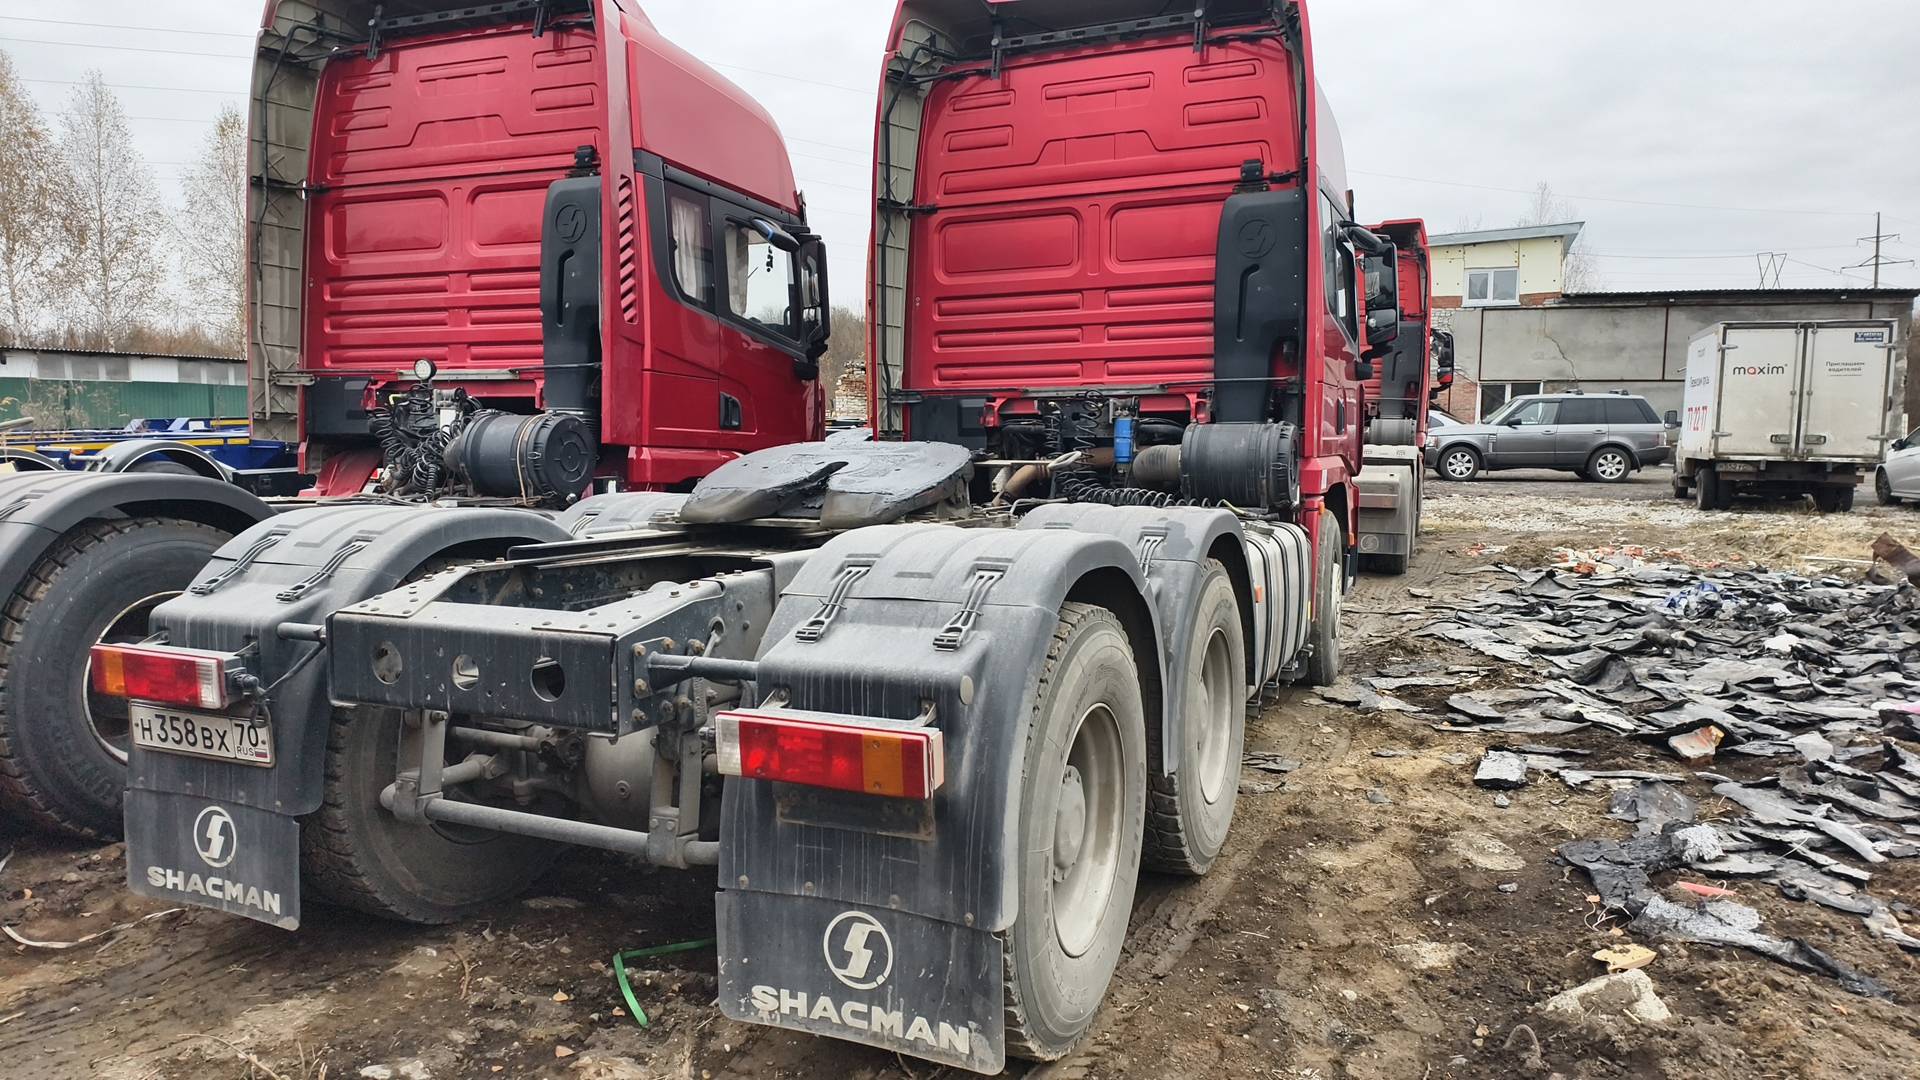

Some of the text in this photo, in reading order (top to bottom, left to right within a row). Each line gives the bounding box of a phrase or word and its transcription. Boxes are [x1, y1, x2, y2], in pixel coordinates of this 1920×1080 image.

[1733, 363, 1784, 375] maxim
[234, 723, 259, 747] 70
[236, 745, 255, 756] RUS
[147, 865, 281, 915] SHACMAN
[751, 985, 969, 1054] SHACMAN
